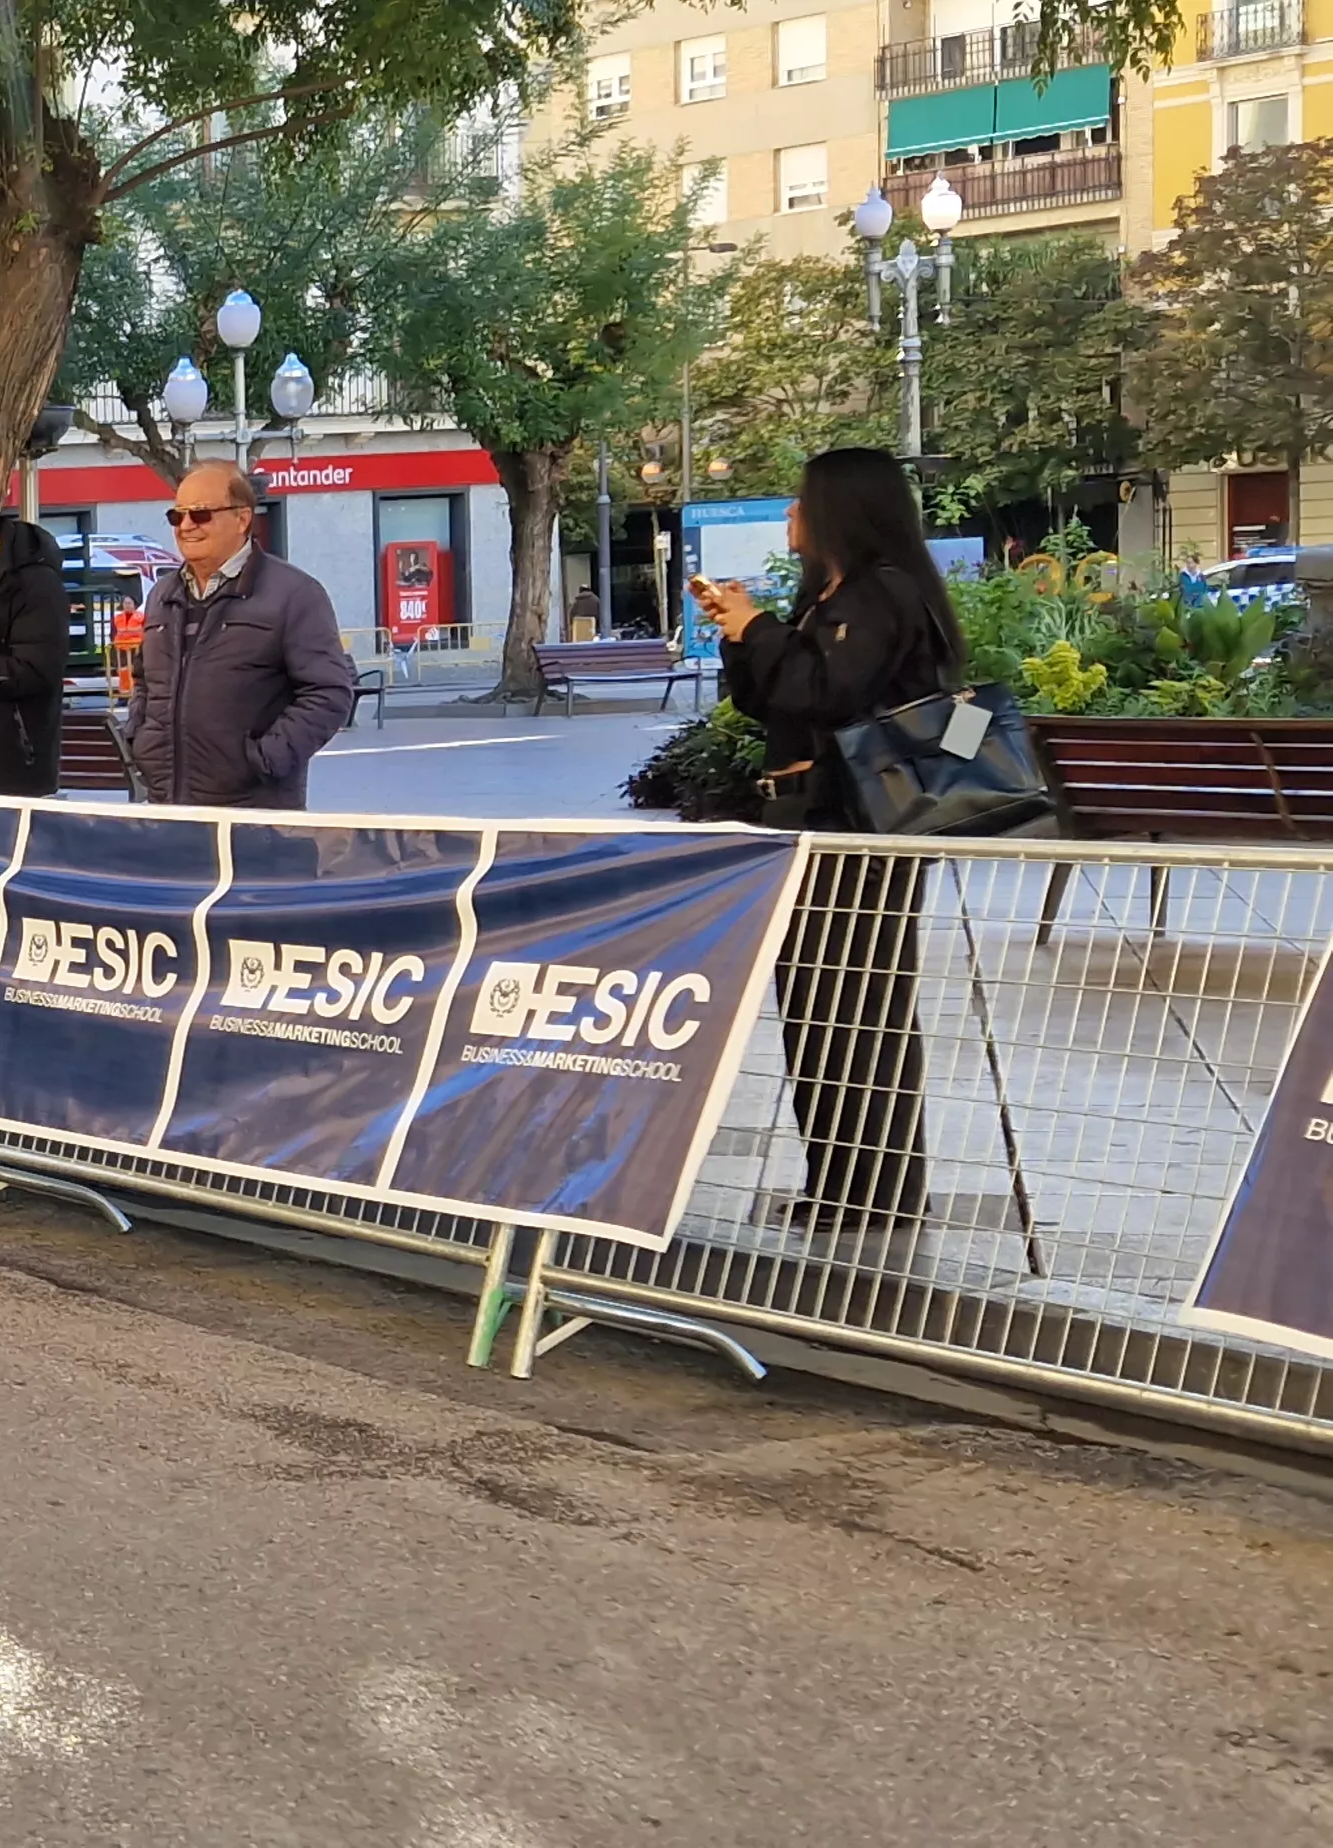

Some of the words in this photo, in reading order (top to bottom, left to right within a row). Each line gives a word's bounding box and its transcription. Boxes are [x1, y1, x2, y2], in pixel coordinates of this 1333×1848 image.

[691, 505, 746, 519] HUESCA
[53, 922, 178, 999] ESIC
[266, 944, 425, 1025] ESIC
[526, 963, 711, 1051] ESIC
